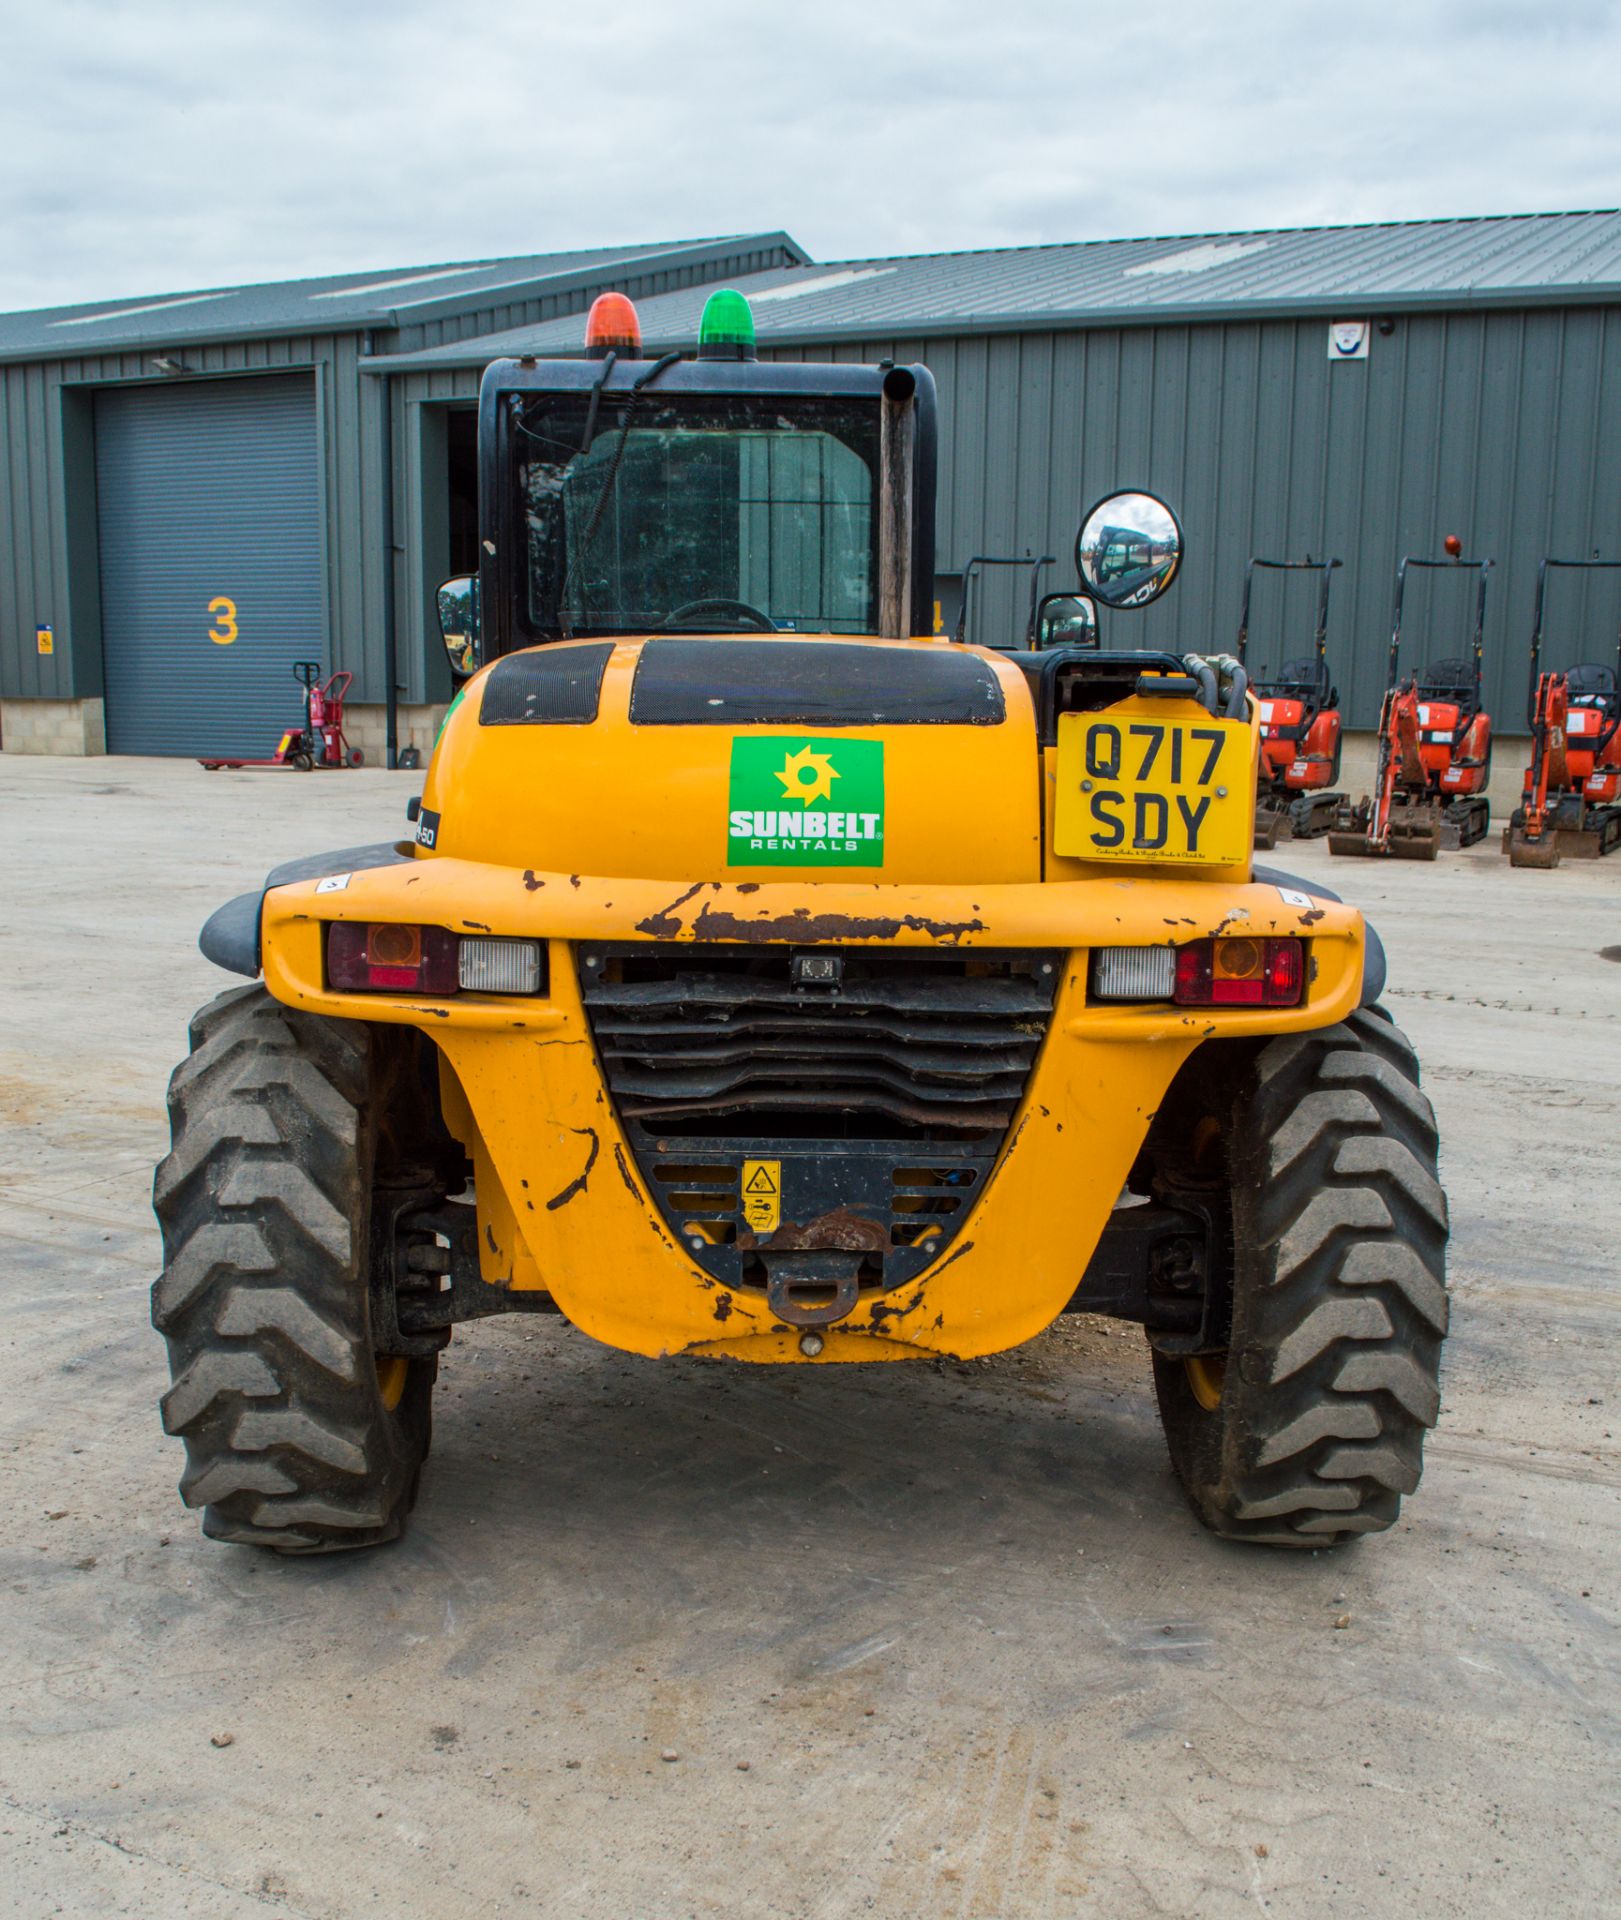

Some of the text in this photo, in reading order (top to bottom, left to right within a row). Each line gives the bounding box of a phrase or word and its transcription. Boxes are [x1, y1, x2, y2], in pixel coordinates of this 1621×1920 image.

[207, 596, 239, 645] 3
[1085, 723, 1226, 785] Q717
[750, 839, 858, 851] RENTALS
[1090, 790, 1211, 852] SDY
